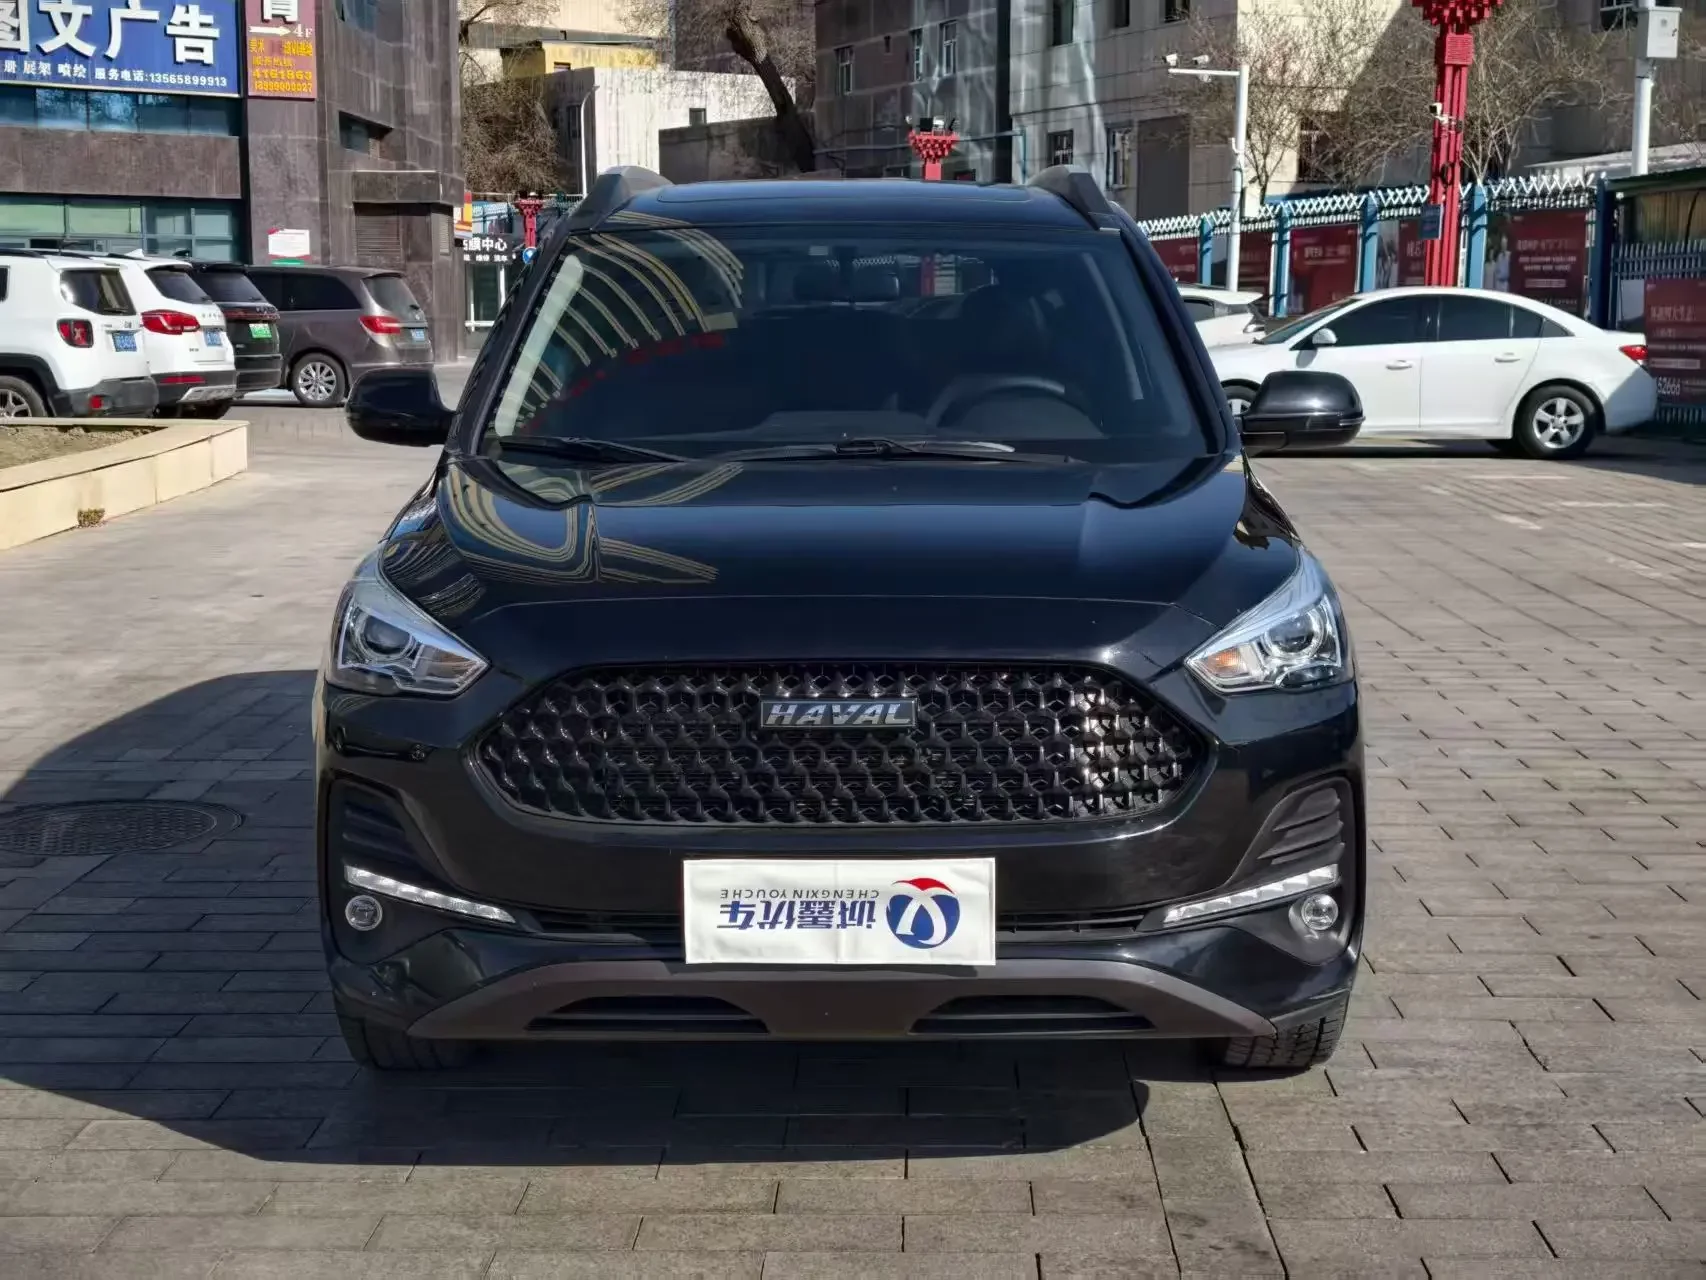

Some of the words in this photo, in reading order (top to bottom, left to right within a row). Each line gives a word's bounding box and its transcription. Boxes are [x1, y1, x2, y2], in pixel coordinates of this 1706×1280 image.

[764, 703, 912, 725] HAVAL
[720, 888, 787, 900] YOUCHE
[792, 888, 880, 900] CHENGXIN
[717, 900, 877, 930] 诚鑫优车
